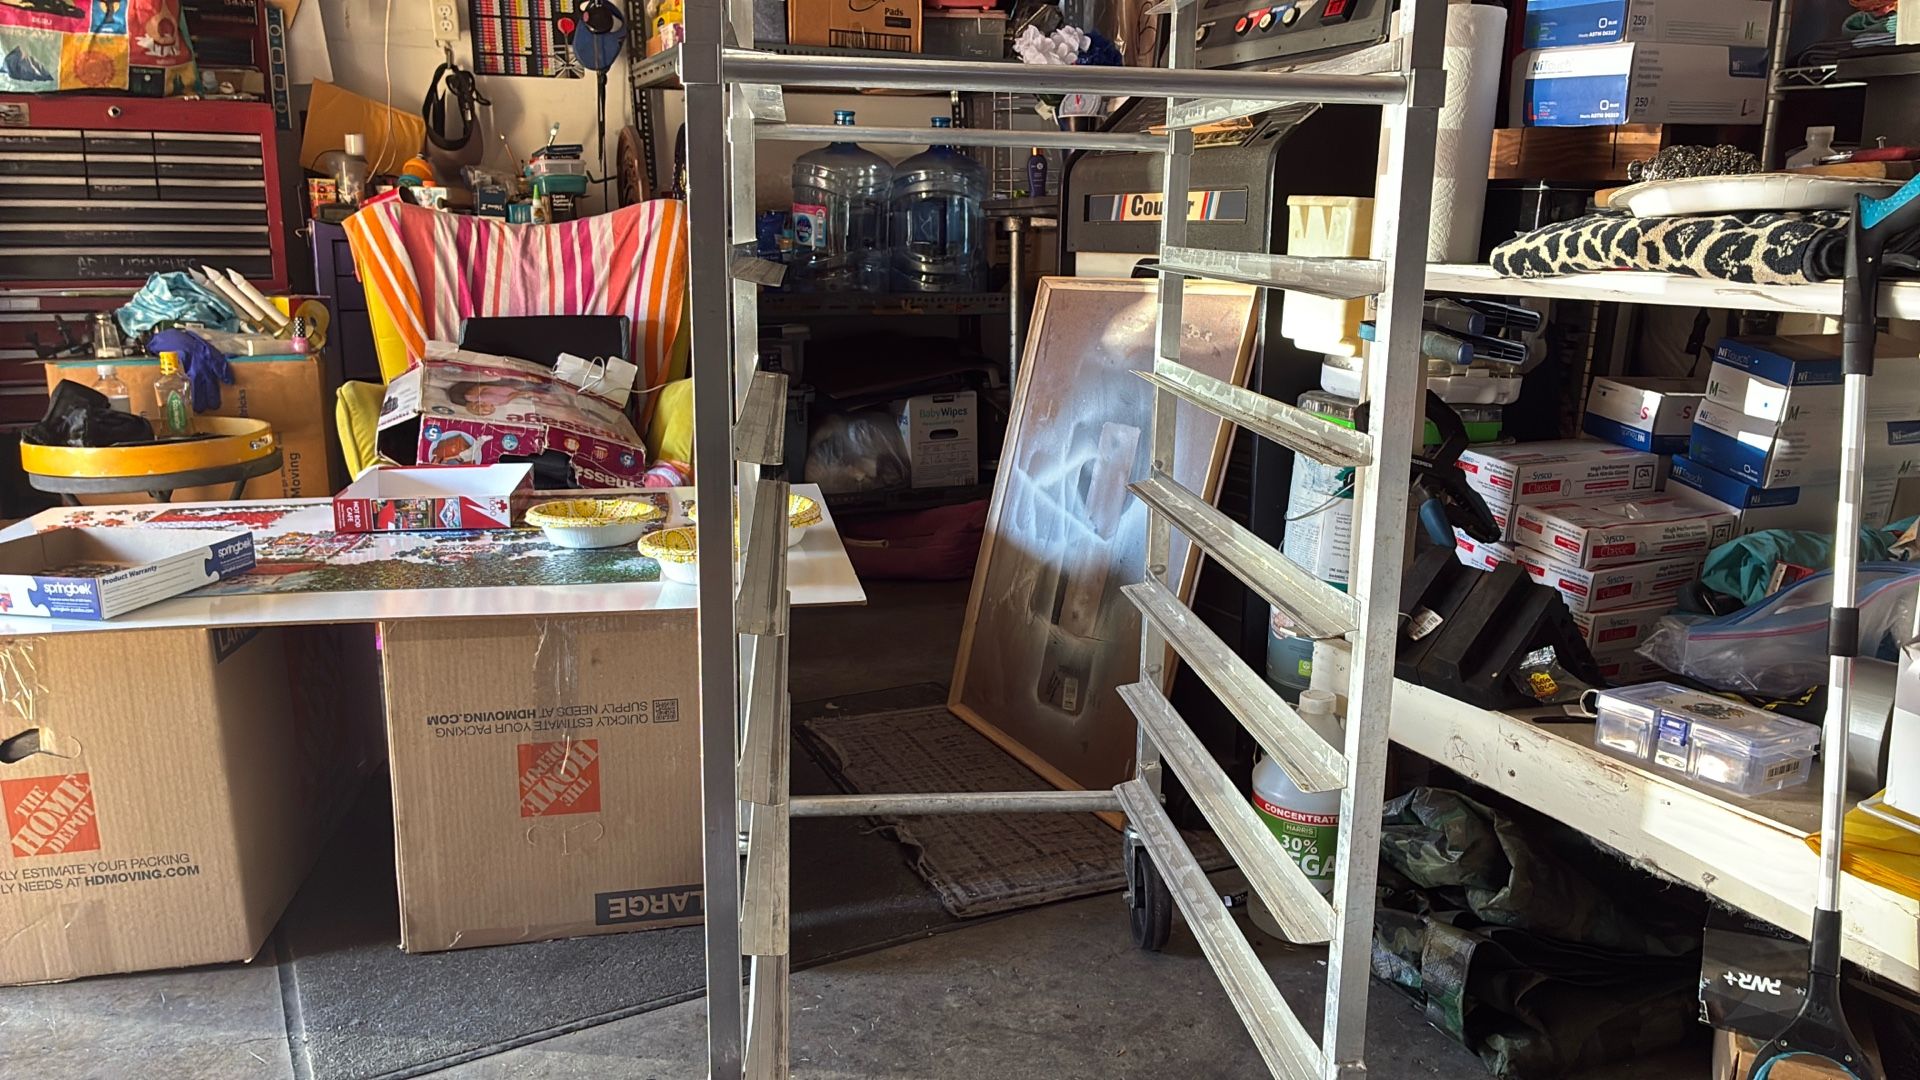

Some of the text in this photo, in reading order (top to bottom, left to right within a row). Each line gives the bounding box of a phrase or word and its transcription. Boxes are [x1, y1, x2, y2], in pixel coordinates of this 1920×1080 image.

[885, 8, 903, 16] Pads
[1633, 15, 1646, 25] 250
[1635, 97, 1648, 107] 250
[1709, 381, 1719, 397] M
[941, 407, 968, 418] Wipes
[1641, 407, 1649, 420] S
[1683, 406, 1691, 419] S
[1788, 406, 1799, 420] M
[429, 428, 438, 439] 5
[506, 413, 632, 443] massage
[289, 452, 300, 498] Moving
[1532, 472, 1552, 480] Sysco
[1774, 470, 1791, 478] 250
[1528, 482, 1553, 493] Classic
[218, 537, 251, 558] springbok
[102, 565, 157, 585] Product Warranty
[44, 582, 92, 597] springbok
[427, 701, 648, 726] SUPPLY NEEDS AT HDMOVING.COM
[436, 713, 648, 738] QUICKLY ESTIMATE YOUR PACKING
[521, 742, 571, 790] DEPOT
[521, 740, 598, 816] HOME
[14, 785, 48, 817] THE
[560, 777, 592, 807] THE
[11, 775, 90, 856] HOME
[47, 802, 95, 853] DEPOT
[1286, 824, 1314, 835] HARRIS
[1281, 834, 1318, 854] 30%
[23, 863, 86, 879] ESTIMATE
[87, 859, 128, 872] YOUR
[131, 853, 190, 868] PACKING
[19, 878, 63, 893] NEEDS
[66, 876, 81, 888] AT
[84, 865, 200, 887] HDMOVING.COM
[608, 890, 704, 919] LARGE
[1723, 971, 1781, 995] PWR+
